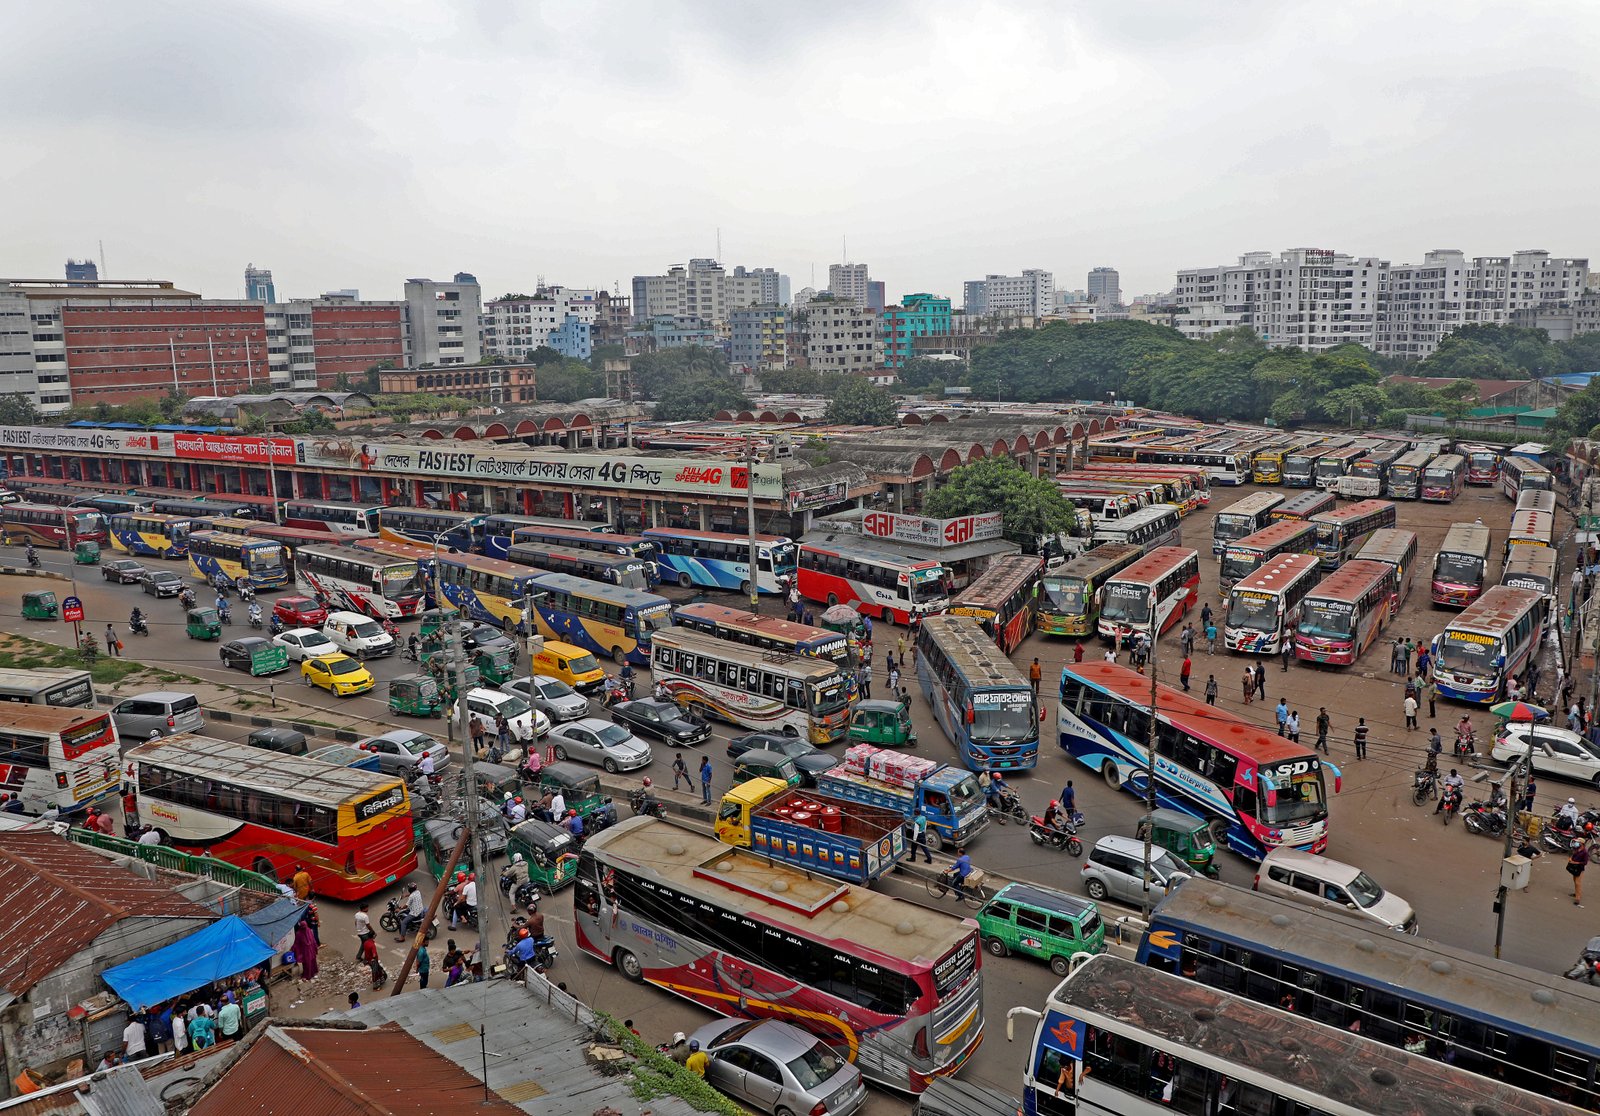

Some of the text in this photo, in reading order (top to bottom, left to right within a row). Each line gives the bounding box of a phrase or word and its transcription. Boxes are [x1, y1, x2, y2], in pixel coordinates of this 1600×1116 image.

[3, 430, 31, 444] FASTEST
[90, 435, 104, 449] 4G
[177, 438, 204, 451] মহাখালী
[244, 443, 259, 455] বাস
[384, 451, 663, 485] দেশের FASTEST নেটওয়ার্কে ঢাকায় সেরা 4G স্পিড
[683, 467, 701, 475] FULL
[699, 468, 723, 485] 4G
[675, 474, 700, 483] SPEED
[816, 639, 848, 655] ANANNA
[1450, 631, 1495, 646] SHOWKHIN
[1061, 718, 1072, 729] HAVE
[1086, 731, 1097, 740] TOUR
[1179, 770, 1213, 794] Enterprise
[362, 795, 401, 817] বিনিময়
[641, 881, 879, 974] ALAM ASIA ALAM ASIA ALAM ASIA ALAM ASIA ASIA ALAM
